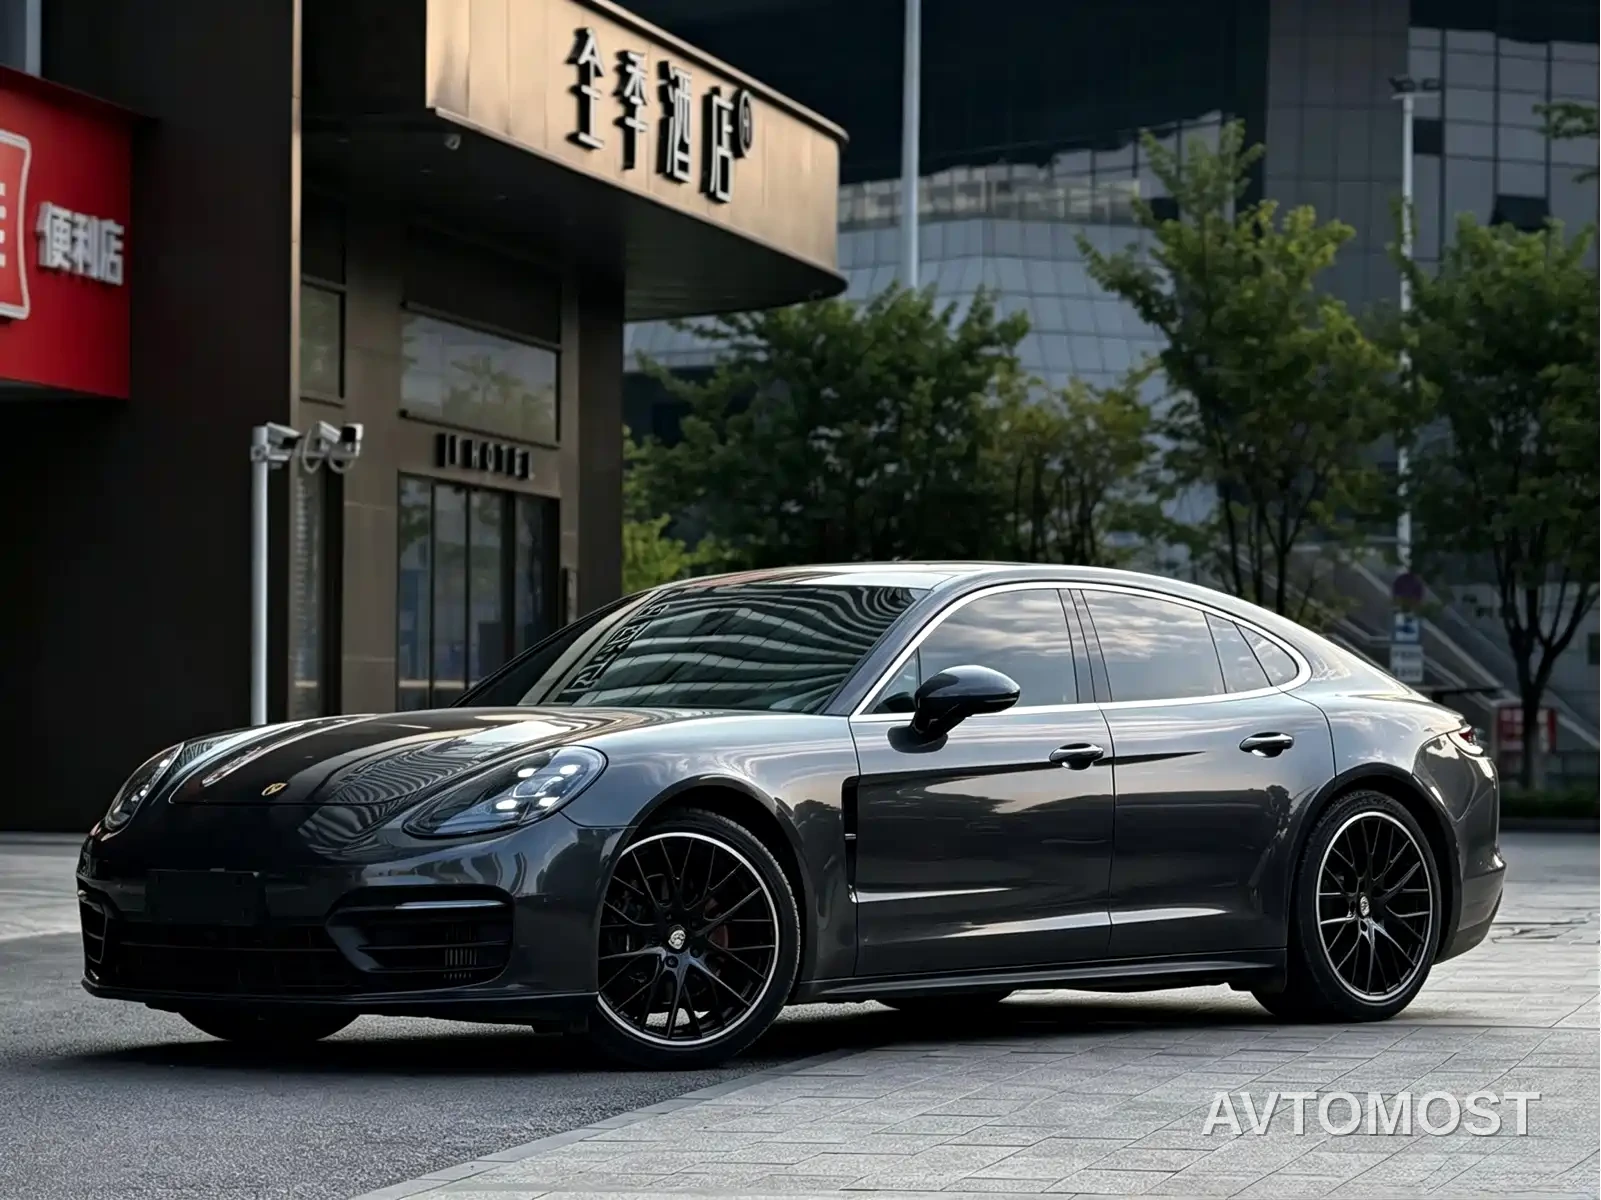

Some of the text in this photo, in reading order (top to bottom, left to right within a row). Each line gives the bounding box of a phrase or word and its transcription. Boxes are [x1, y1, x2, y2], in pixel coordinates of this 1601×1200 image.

[566, 26, 735, 203] 全季酒店
[36, 201, 124, 286] 便利店
[463, 438, 536, 481] HOTEL
